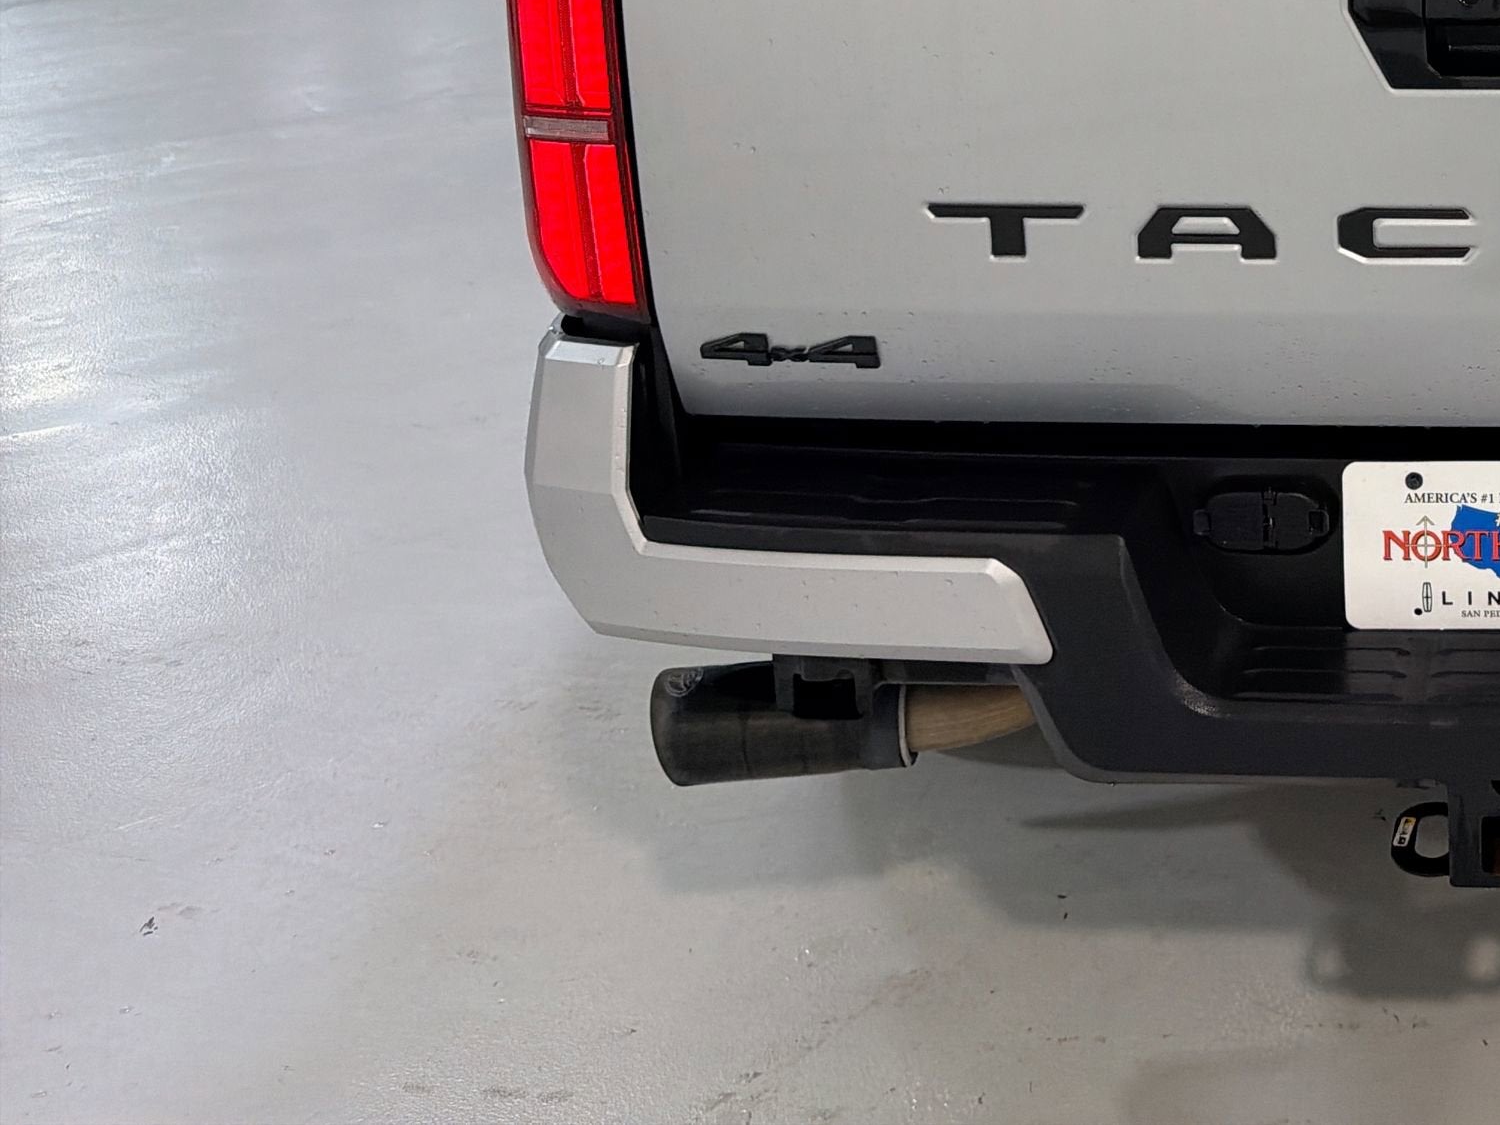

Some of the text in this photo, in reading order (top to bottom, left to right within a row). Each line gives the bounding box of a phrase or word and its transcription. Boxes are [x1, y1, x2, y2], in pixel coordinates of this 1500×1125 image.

[1404, 491, 1477, 504] AMERICA'S
[1480, 492, 1494, 504] #1
[1461, 610, 1481, 618] SAN
